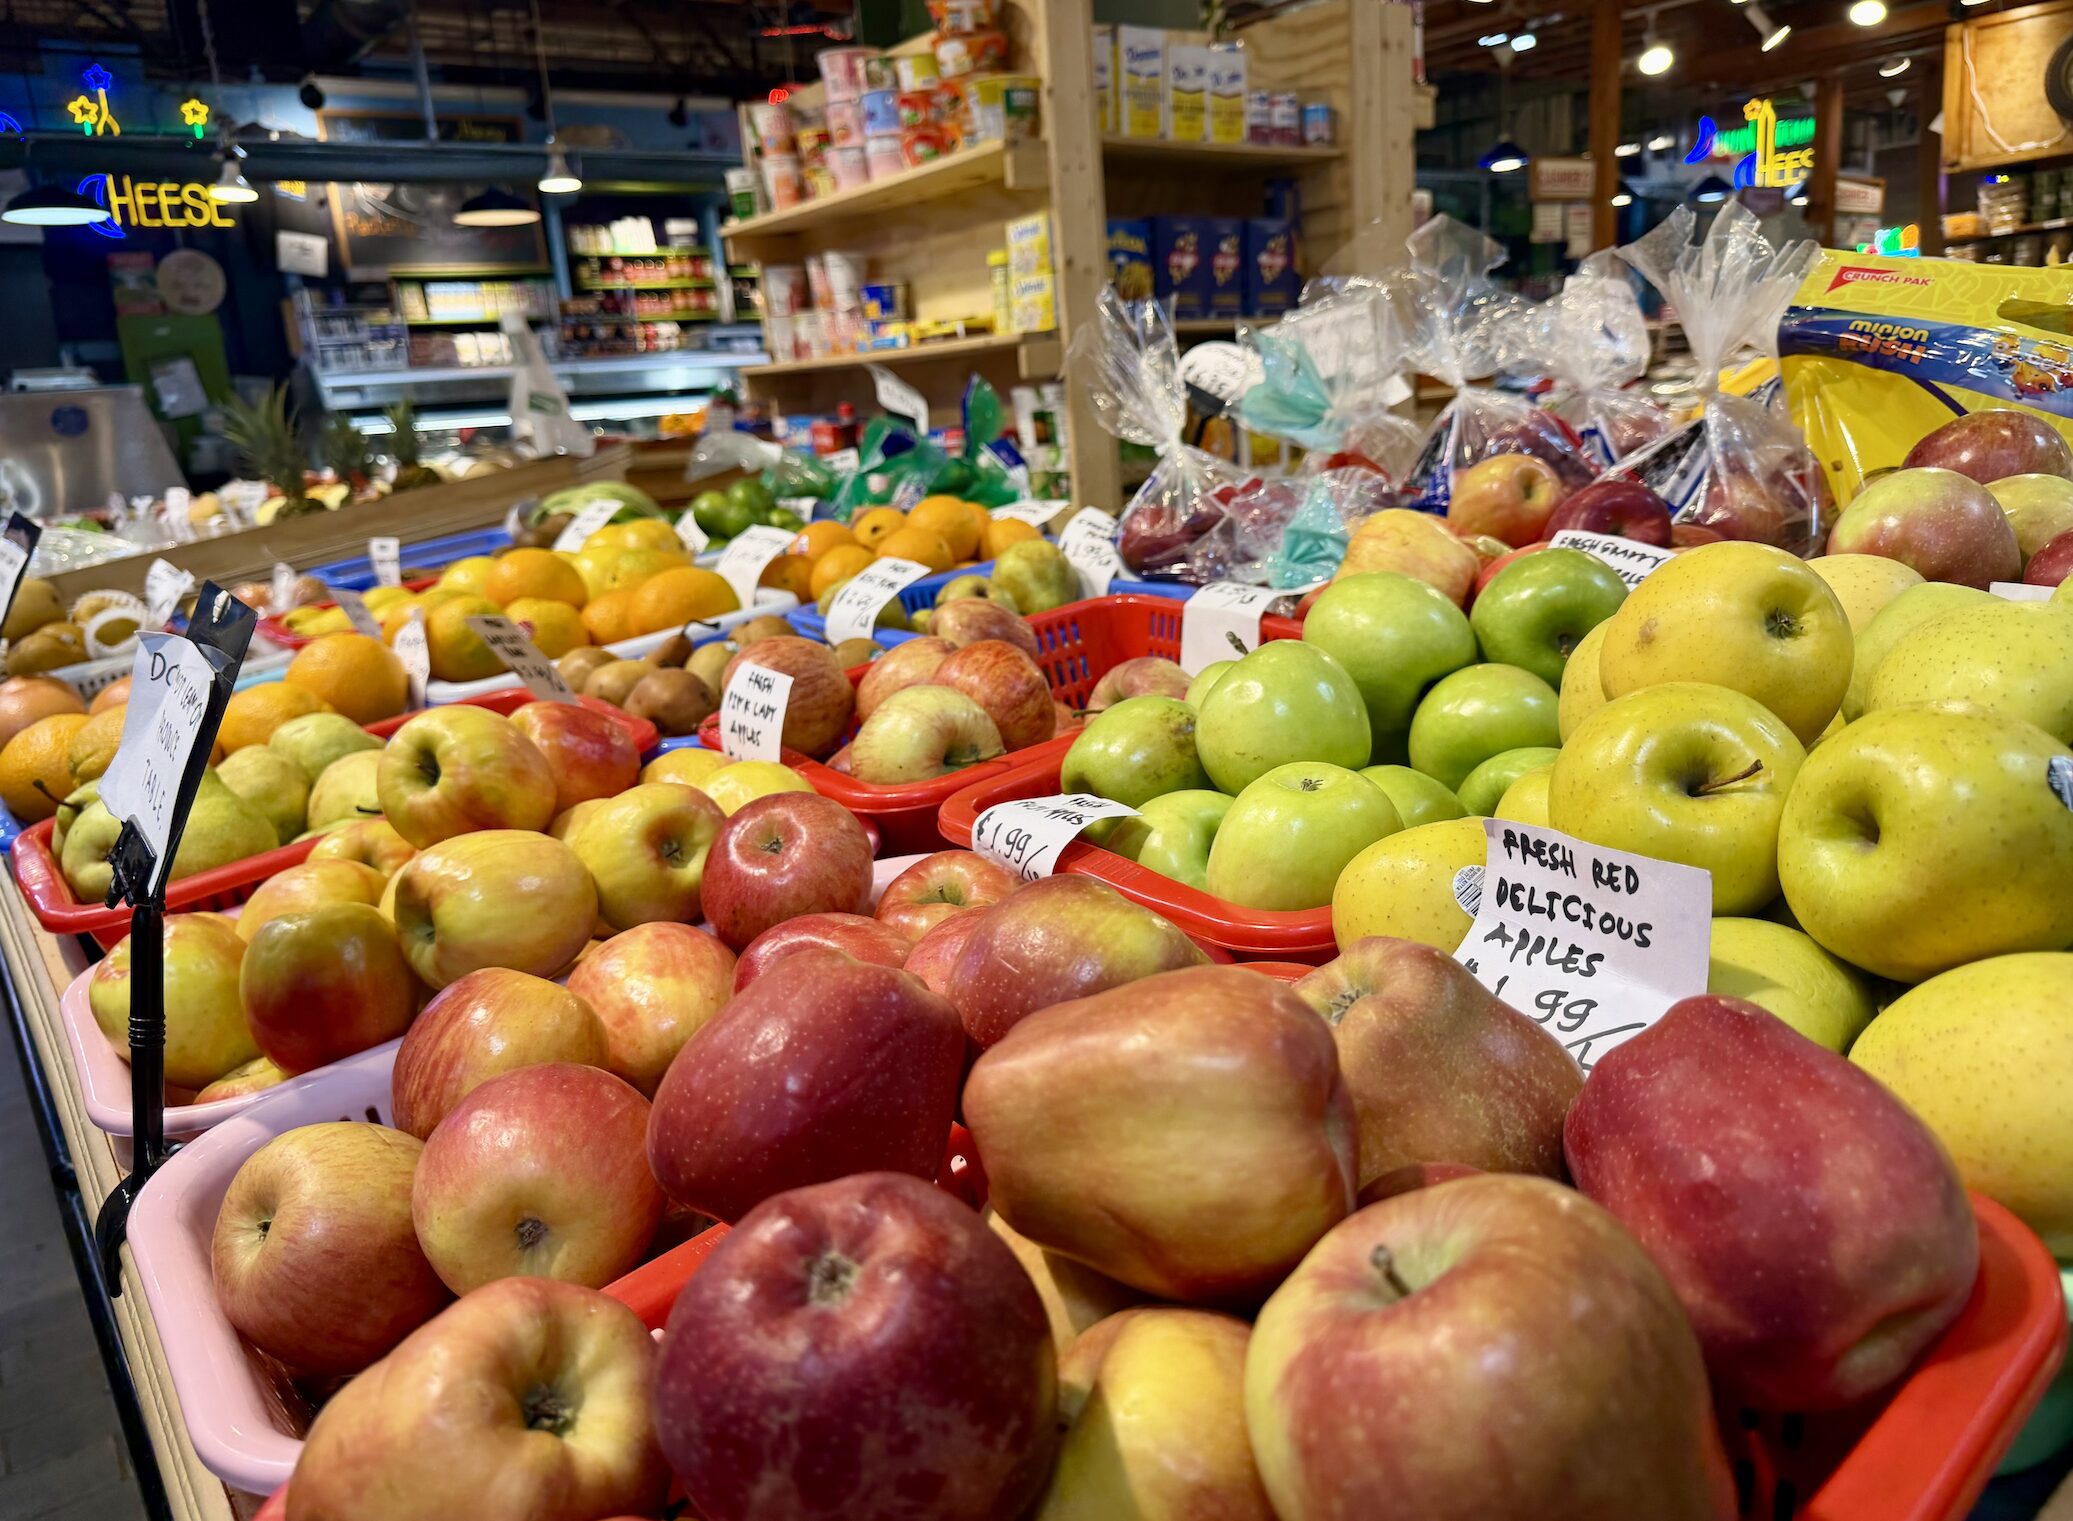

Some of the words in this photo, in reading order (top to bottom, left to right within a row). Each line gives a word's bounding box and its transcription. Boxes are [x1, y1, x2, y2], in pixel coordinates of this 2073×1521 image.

[1843, 270, 1899, 284] CRUNCH
[1902, 277, 1930, 286] PAK
[1838, 333, 1927, 366] RUSH
[1559, 536, 1602, 553] FRESH
[753, 701, 778, 723] LADY
[157, 708, 181, 762] PRODUCE
[1502, 828, 1577, 879] FRESH
[1592, 857, 1640, 895] RED
[1496, 876, 1653, 948] DELICIOUS
[1483, 921, 1605, 978] APPLES
